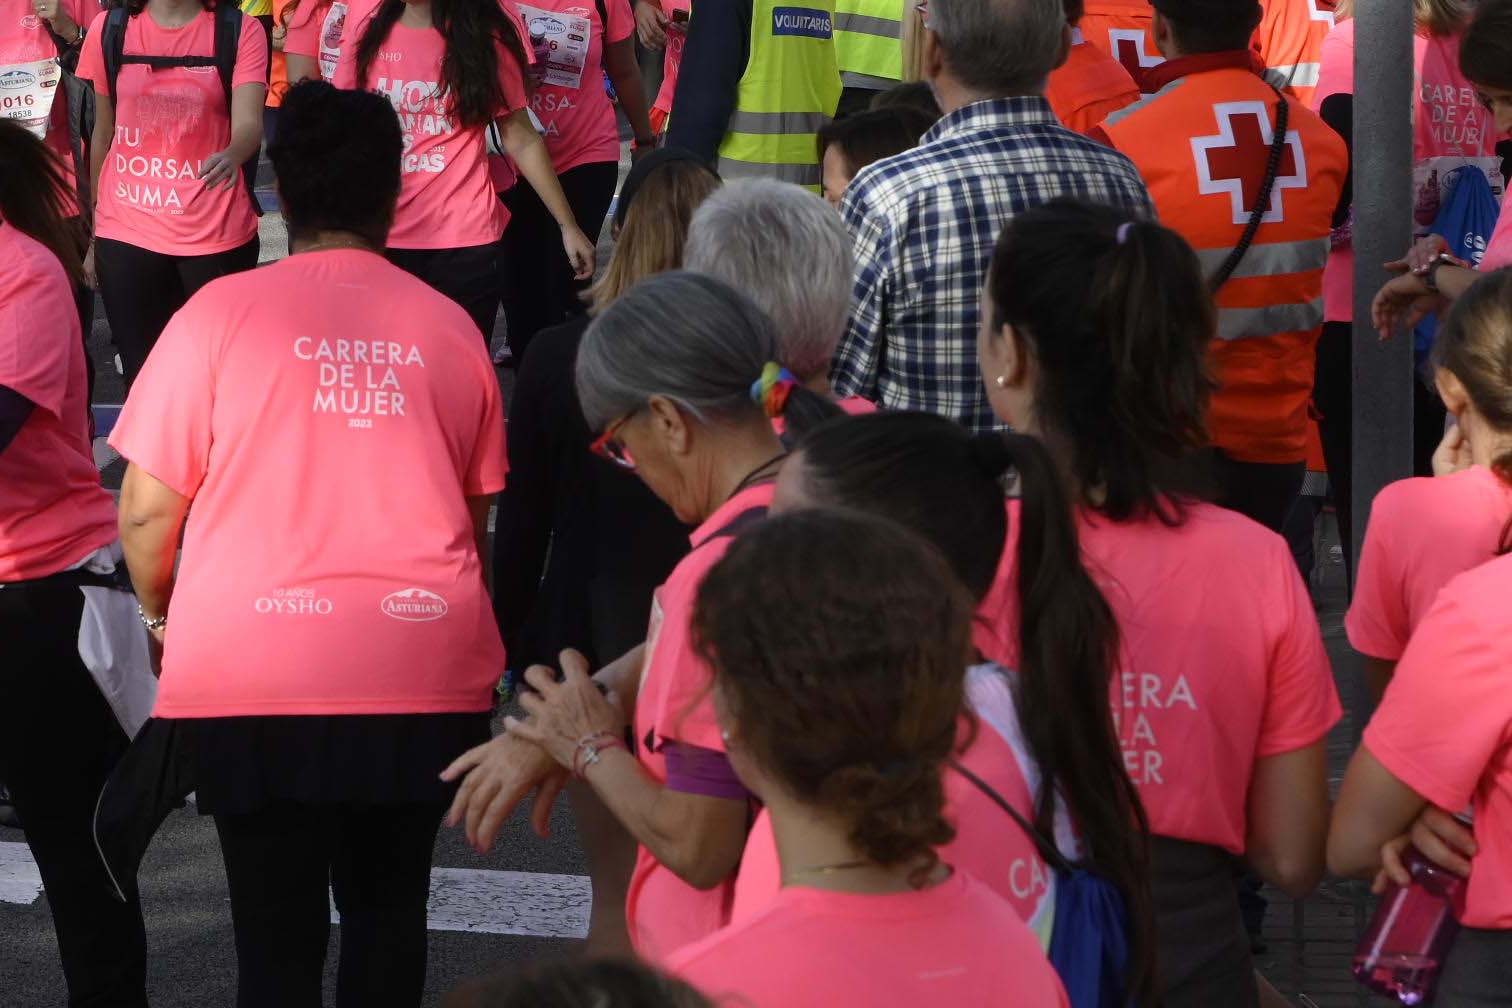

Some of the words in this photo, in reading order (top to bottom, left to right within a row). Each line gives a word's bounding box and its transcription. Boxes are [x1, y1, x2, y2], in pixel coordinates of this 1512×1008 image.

[0, 77, 33, 86] ASTURIANA
[3, 94, 34, 108] 016
[8, 110, 32, 118] 18538
[115, 125, 140, 146] TU
[115, 181, 182, 208] SUMA
[294, 336, 425, 369] CARRERA
[319, 363, 355, 388] DE
[366, 365, 401, 390] LA
[313, 388, 406, 417] MUJER
[348, 418, 373, 428] 2023
[255, 597, 333, 615] OYSHO
[387, 600, 443, 616] ASTURIANA
